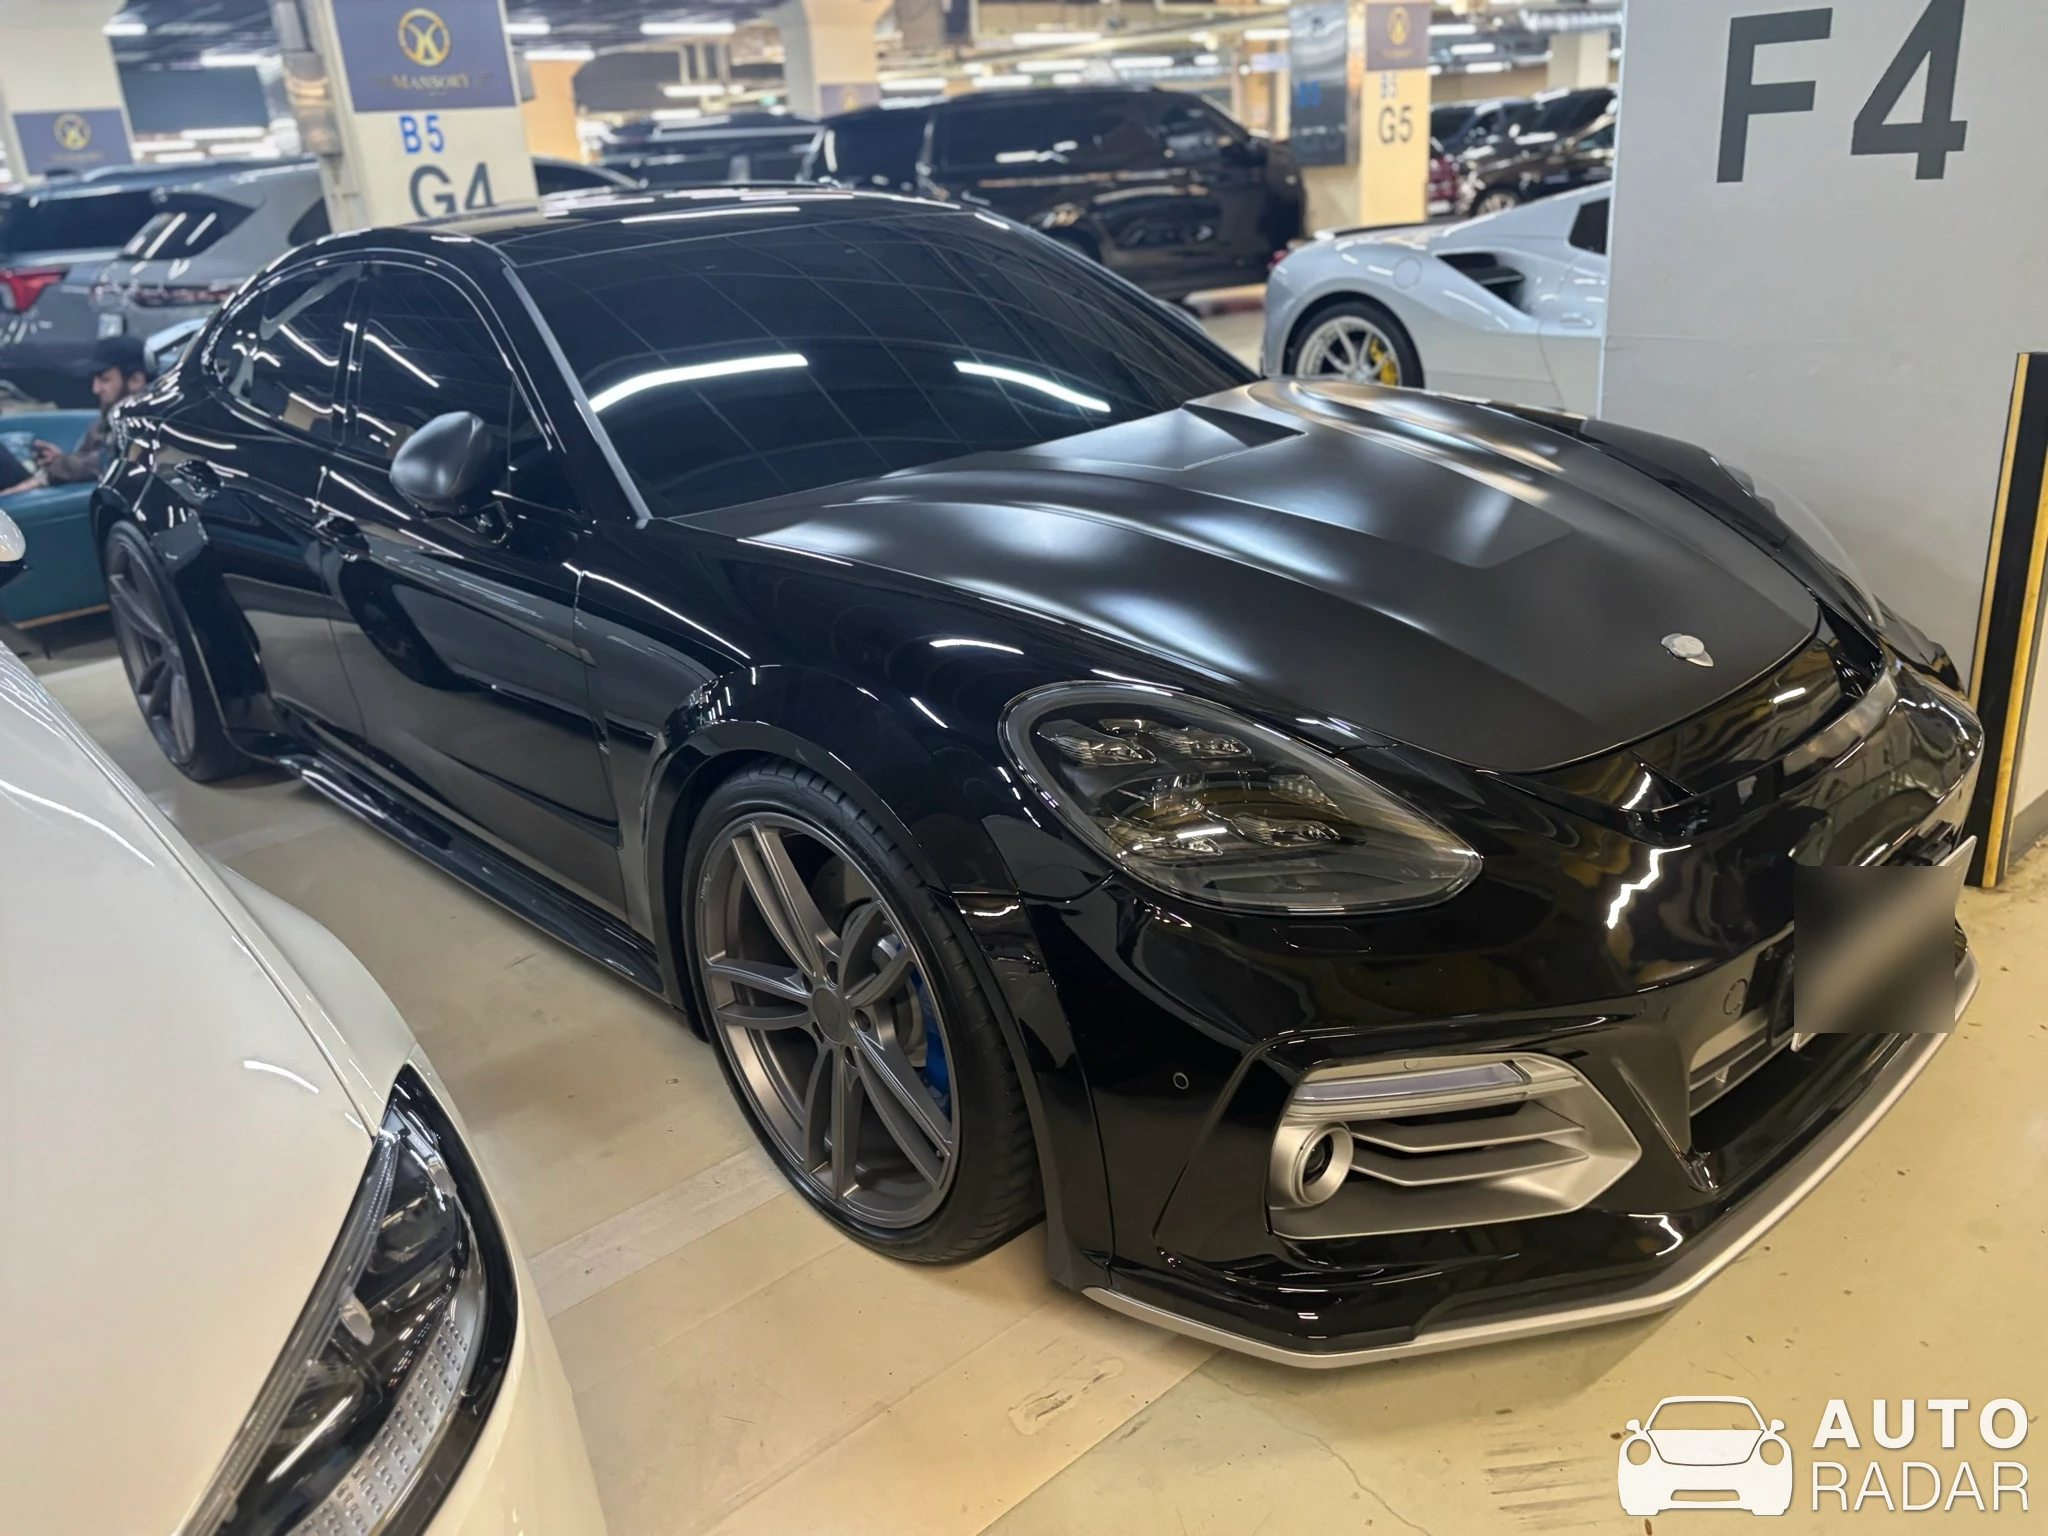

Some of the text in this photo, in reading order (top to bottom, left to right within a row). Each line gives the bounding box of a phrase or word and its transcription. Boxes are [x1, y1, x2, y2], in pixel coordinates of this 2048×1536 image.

[1717, 0, 1968, 184] F4
[399, 113, 445, 154] B5
[1378, 105, 1413, 144] G5
[409, 161, 496, 219] G4
